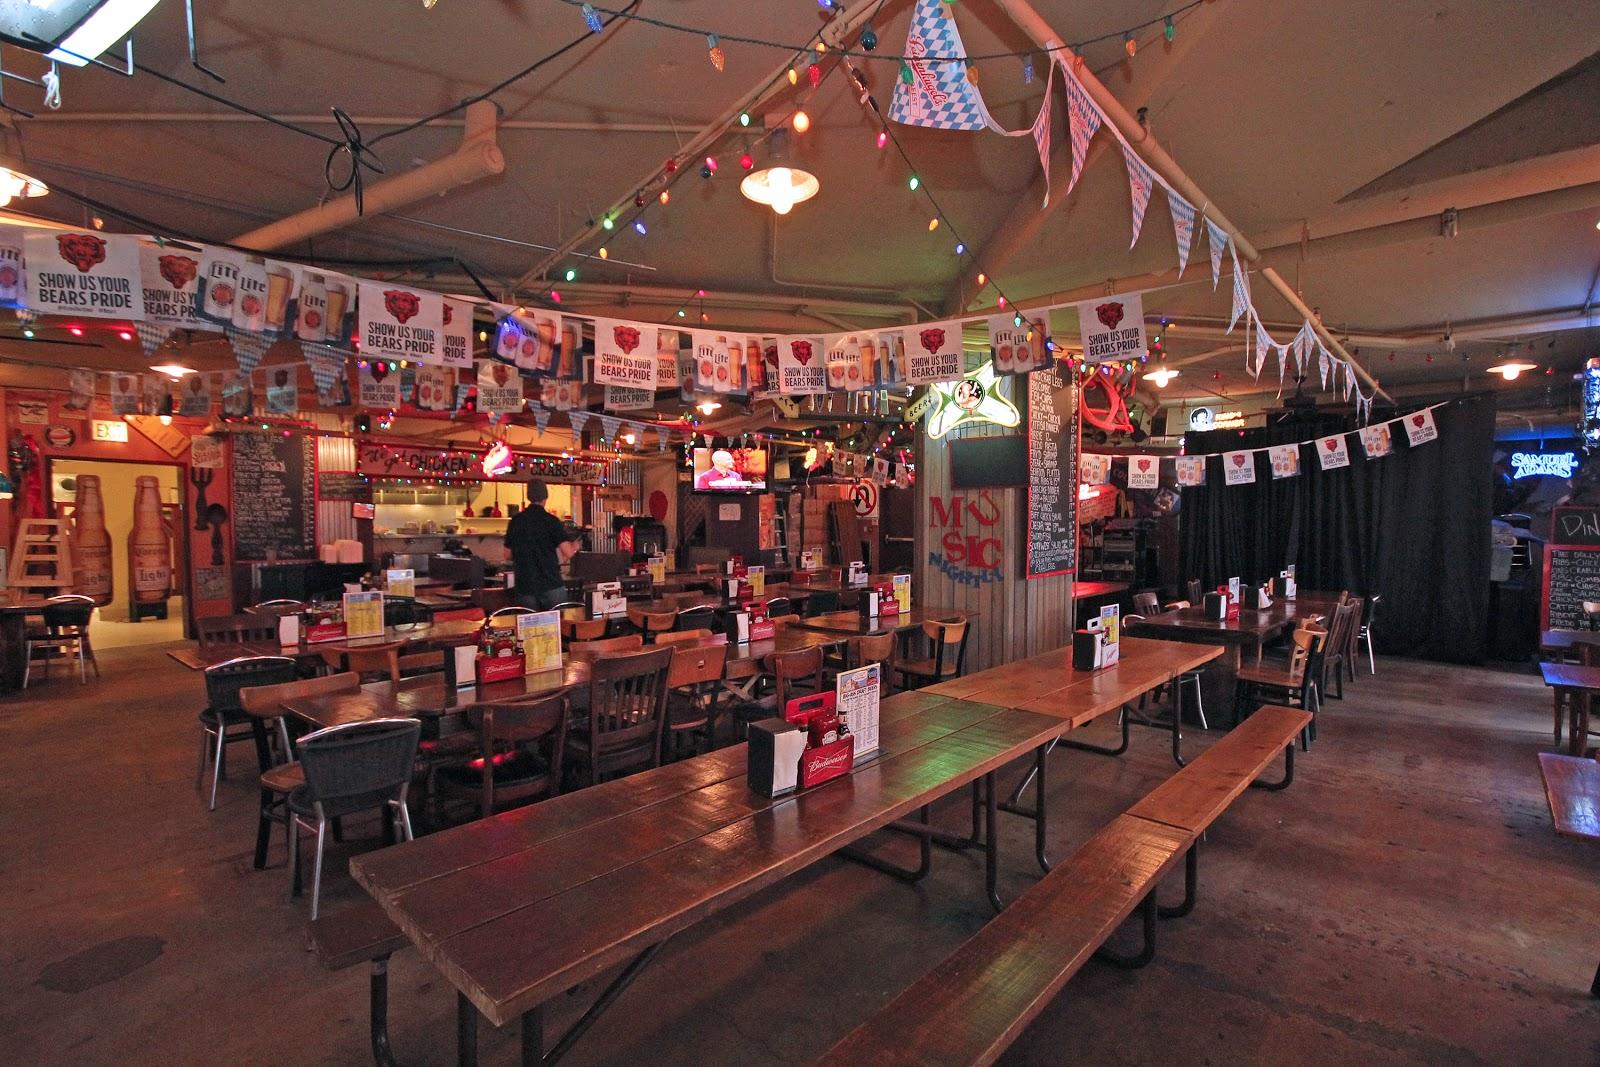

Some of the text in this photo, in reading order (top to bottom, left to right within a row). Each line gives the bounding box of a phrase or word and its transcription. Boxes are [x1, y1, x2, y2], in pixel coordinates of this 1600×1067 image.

[39, 272, 130, 293] SHOW US YOUR
[39, 288, 132, 308] BEARS PRIDE
[143, 288, 171, 304] SHOW
[173, 290, 186, 304] US
[368, 322, 434, 342] SHOW US YOUR
[1089, 328, 1139, 346] SHOW US YOUR
[368, 335, 402, 350] BEARS
[405, 340, 434, 354] PRIDE
[445, 335, 466, 347] YOUR
[1090, 343, 1116, 356] BEARS
[1117, 340, 1140, 350] PRIDE
[443, 346, 466, 359] RIDE
[602, 353, 651, 370] SHOW US YOUR
[912, 354, 958, 368] SHOW US YOUR
[601, 366, 651, 380] BEARS PRIDE
[785, 367, 824, 376] SHOW US YOUR
[912, 366, 934, 378] BEARS
[936, 365, 958, 375] PRIDE
[785, 378, 824, 386] BEARS PRIDE
[610, 394, 650, 404] BEARS PRIDE
[409, 454, 468, 472] CHICKEN
[1511, 452, 1578, 467] SAMUEL
[530, 462, 569, 477] CRABS
[1514, 465, 1572, 479] ADAMS
[808, 754, 848, 772] Budweiser
